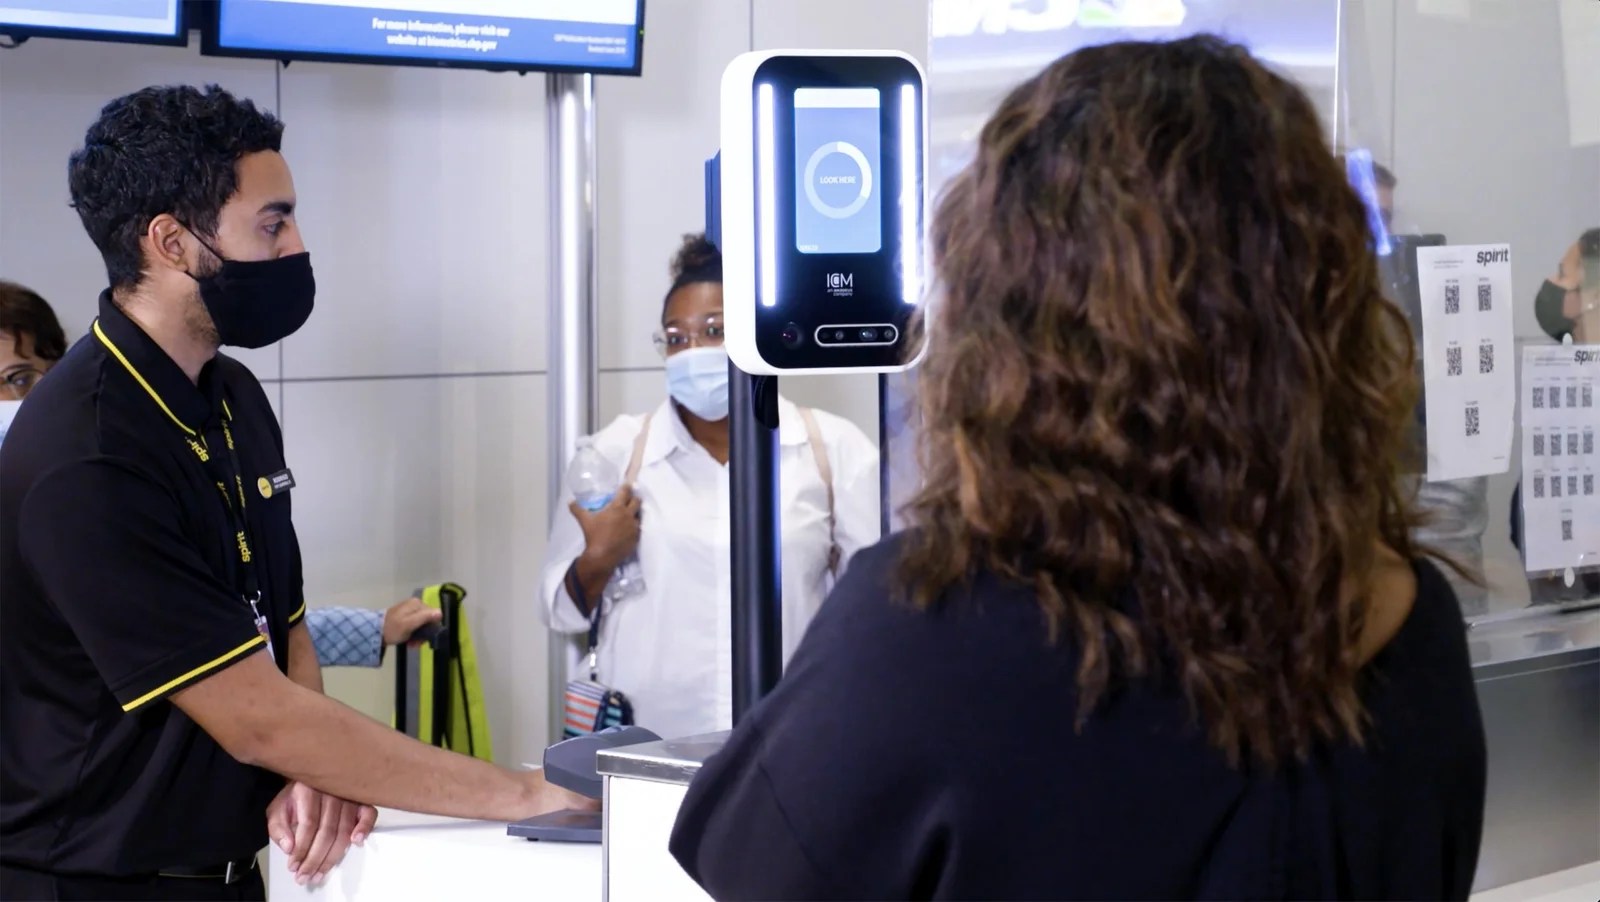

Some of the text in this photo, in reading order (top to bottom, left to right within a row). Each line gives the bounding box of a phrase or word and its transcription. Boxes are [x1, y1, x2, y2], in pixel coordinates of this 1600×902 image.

[372, 18, 386, 29] For
[386, 21, 407, 30] more
[820, 176, 856, 184] LOOK HERE
[1476, 248, 1509, 267] spirit
[1573, 349, 1600, 366] spiri
[236, 530, 252, 563] spirit
